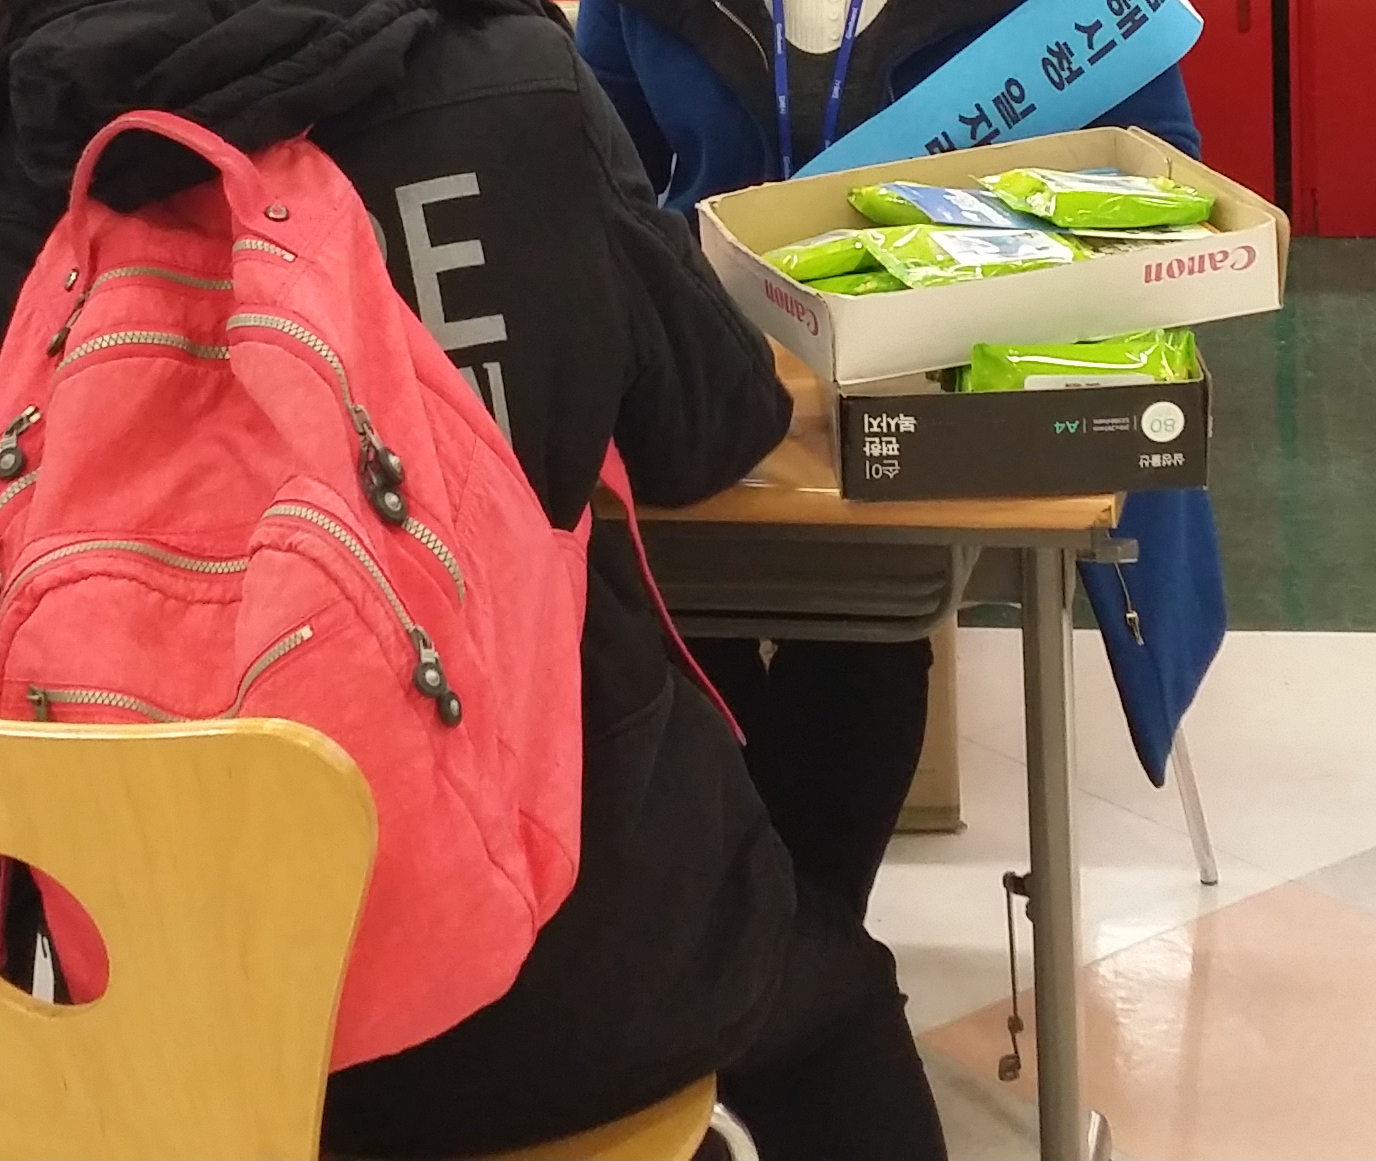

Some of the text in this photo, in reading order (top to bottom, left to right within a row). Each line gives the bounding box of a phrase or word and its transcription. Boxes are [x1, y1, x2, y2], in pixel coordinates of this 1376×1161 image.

[1143, 243, 1258, 285] Canon
[764, 278, 820, 338] Canon
[863, 413, 918, 434] 복사지
[1053, 419, 1080, 434] A4
[1150, 418, 1176, 433] 80
[863, 436, 901, 457] 편한
[865, 460, 901, 480] 손이
[1138, 452, 1186, 469] 삼성물산
